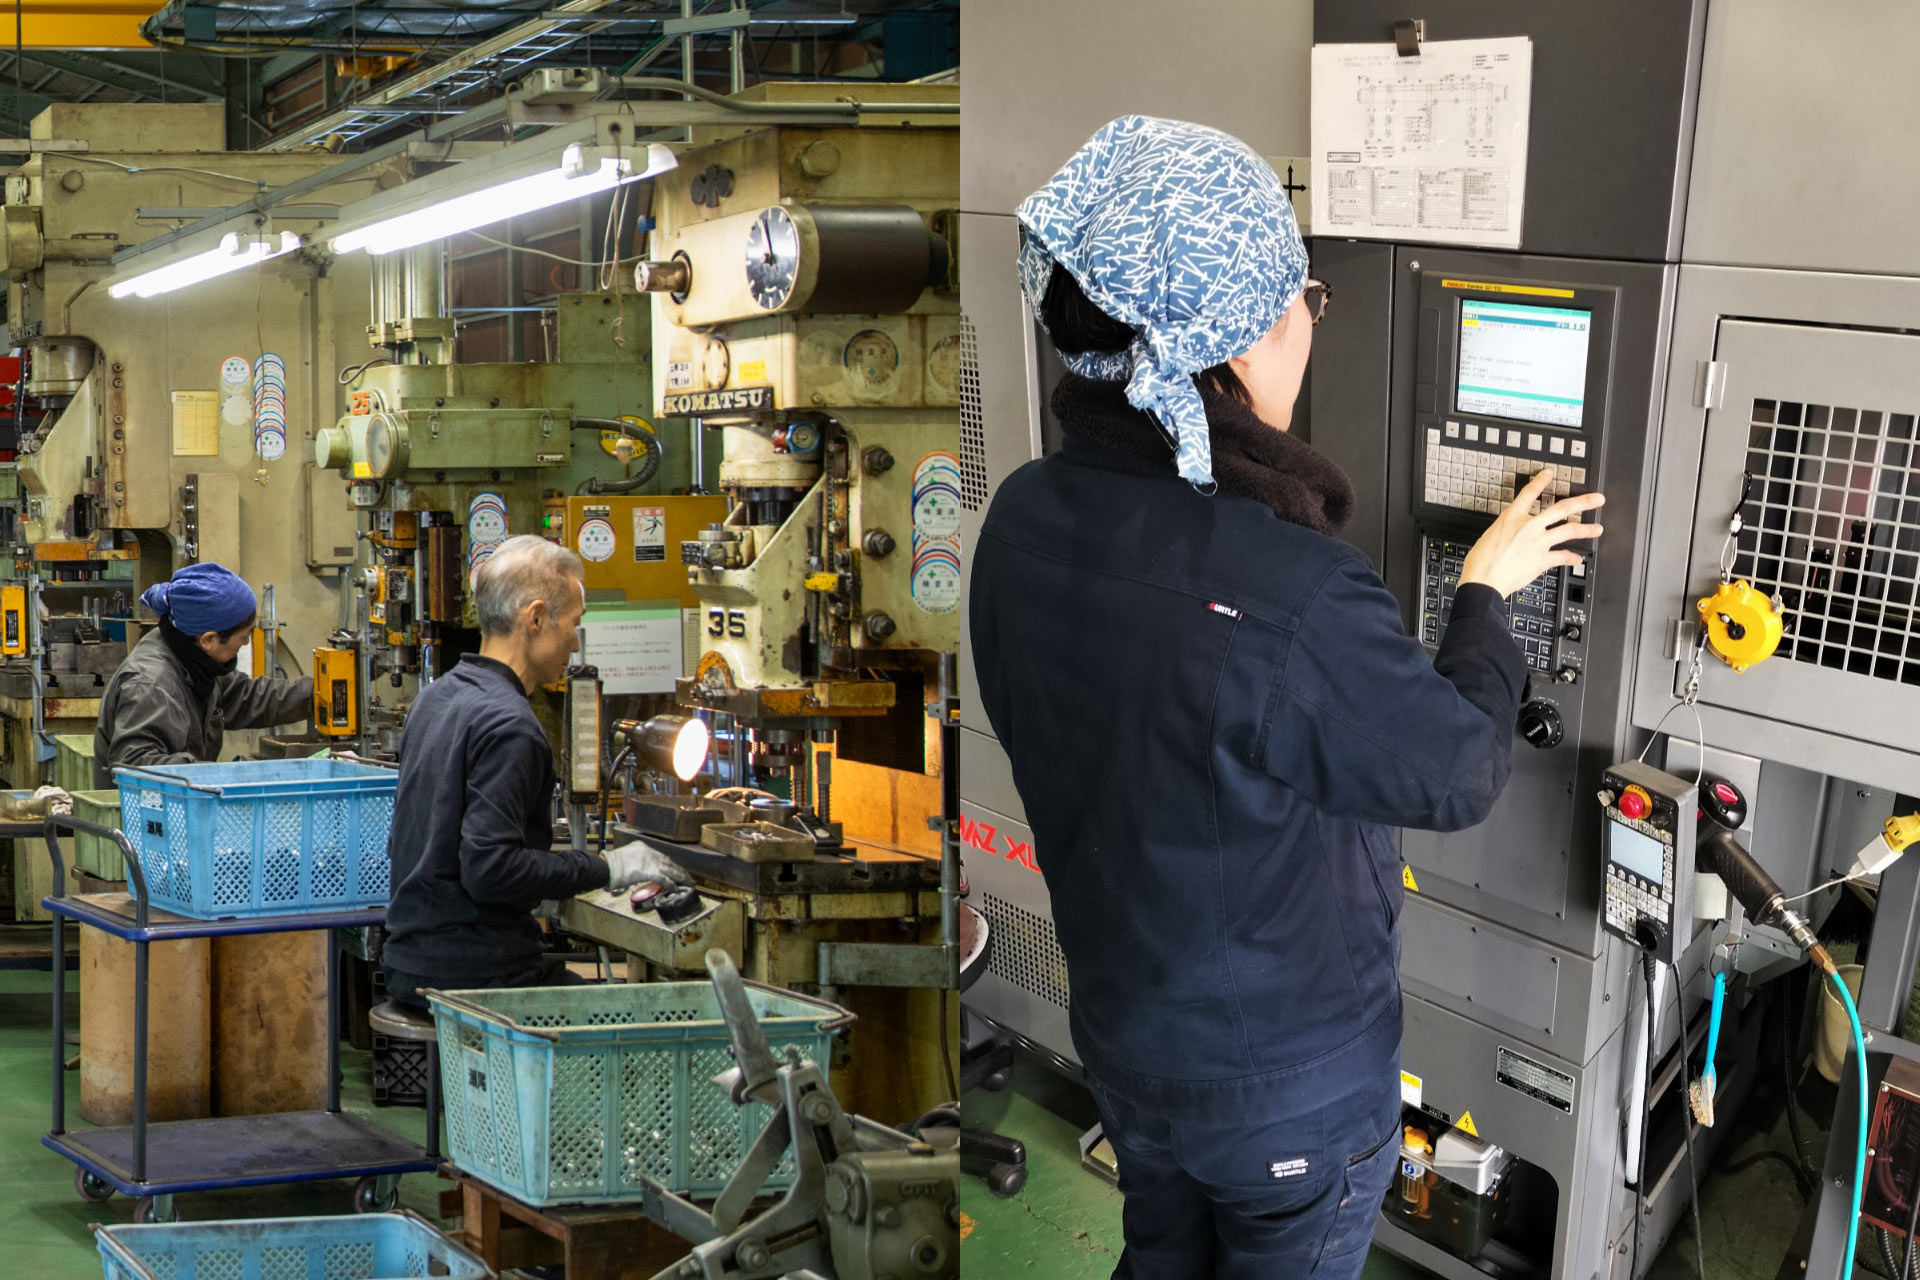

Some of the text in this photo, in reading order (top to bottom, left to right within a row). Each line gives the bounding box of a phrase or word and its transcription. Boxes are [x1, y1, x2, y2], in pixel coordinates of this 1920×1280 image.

[352, 391, 370, 416] 25
[664, 389, 764, 413] KOMATSU
[708, 607, 746, 638] 35
